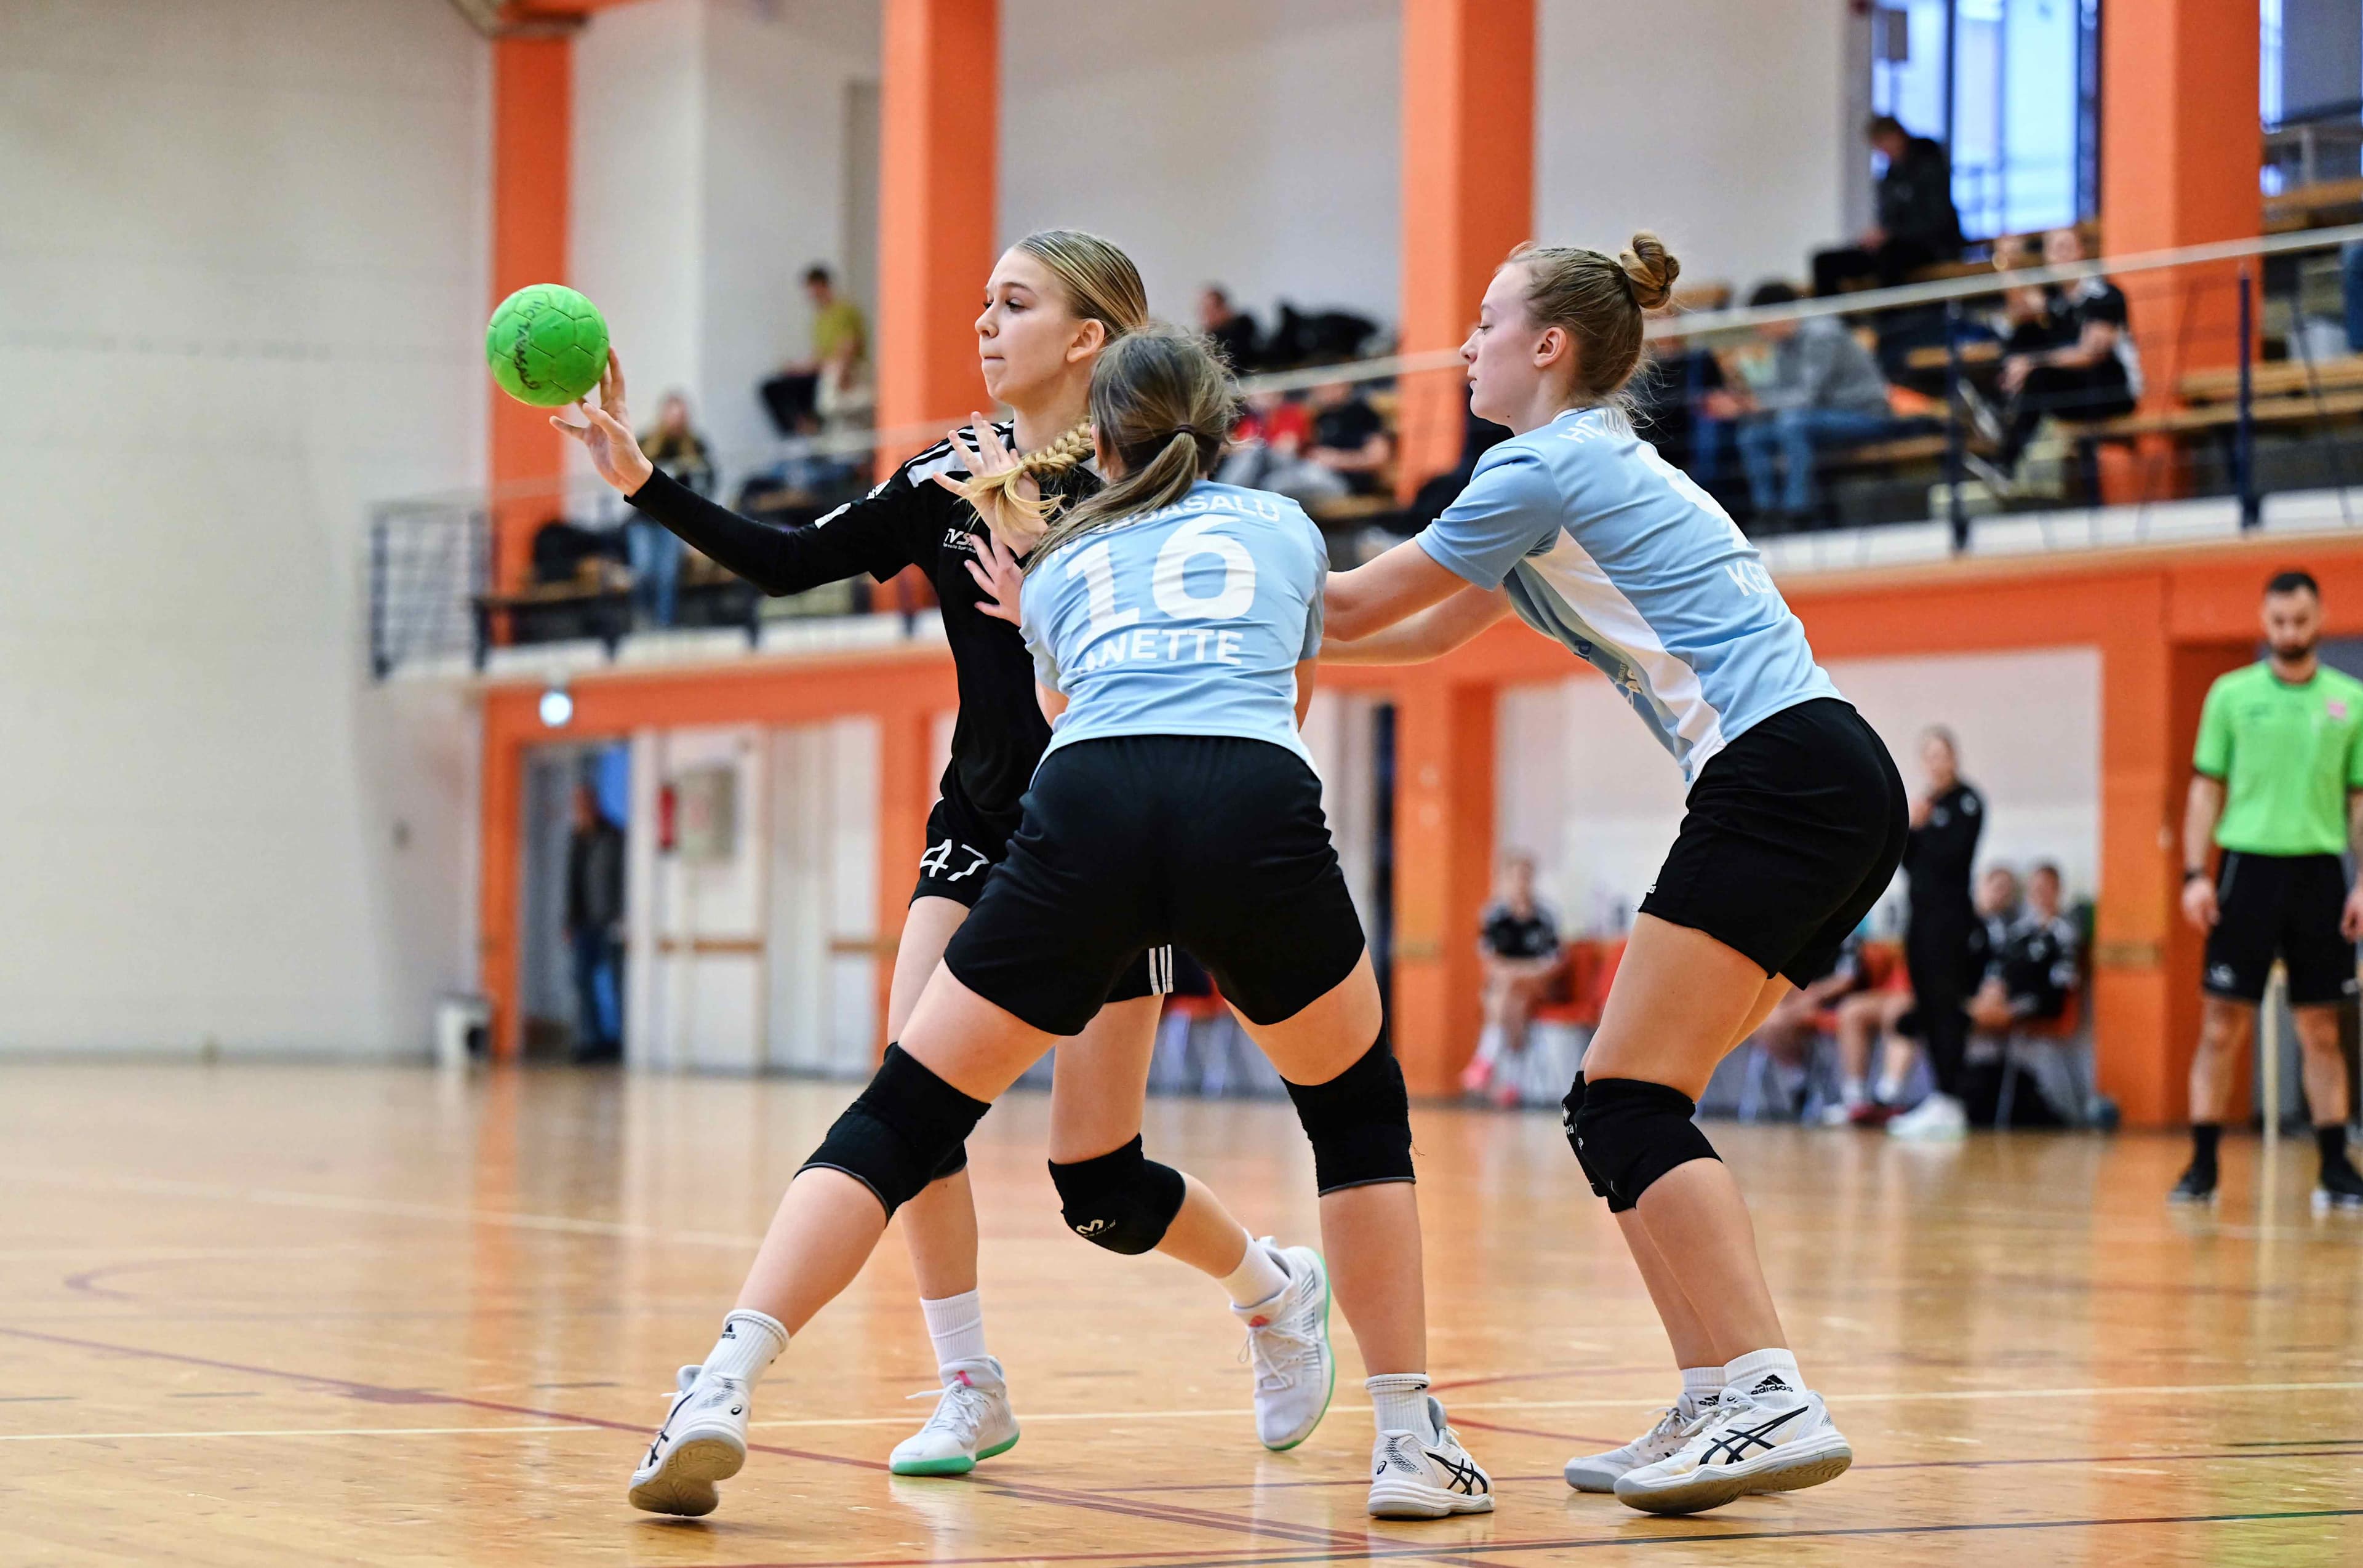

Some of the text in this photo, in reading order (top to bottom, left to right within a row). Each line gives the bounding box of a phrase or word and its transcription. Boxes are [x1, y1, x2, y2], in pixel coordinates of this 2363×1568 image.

[1094, 495, 1280, 533] ASALU
[1066, 514, 1256, 652] 16
[919, 839, 990, 881] 47
[1751, 1385, 1793, 1395] adidas
